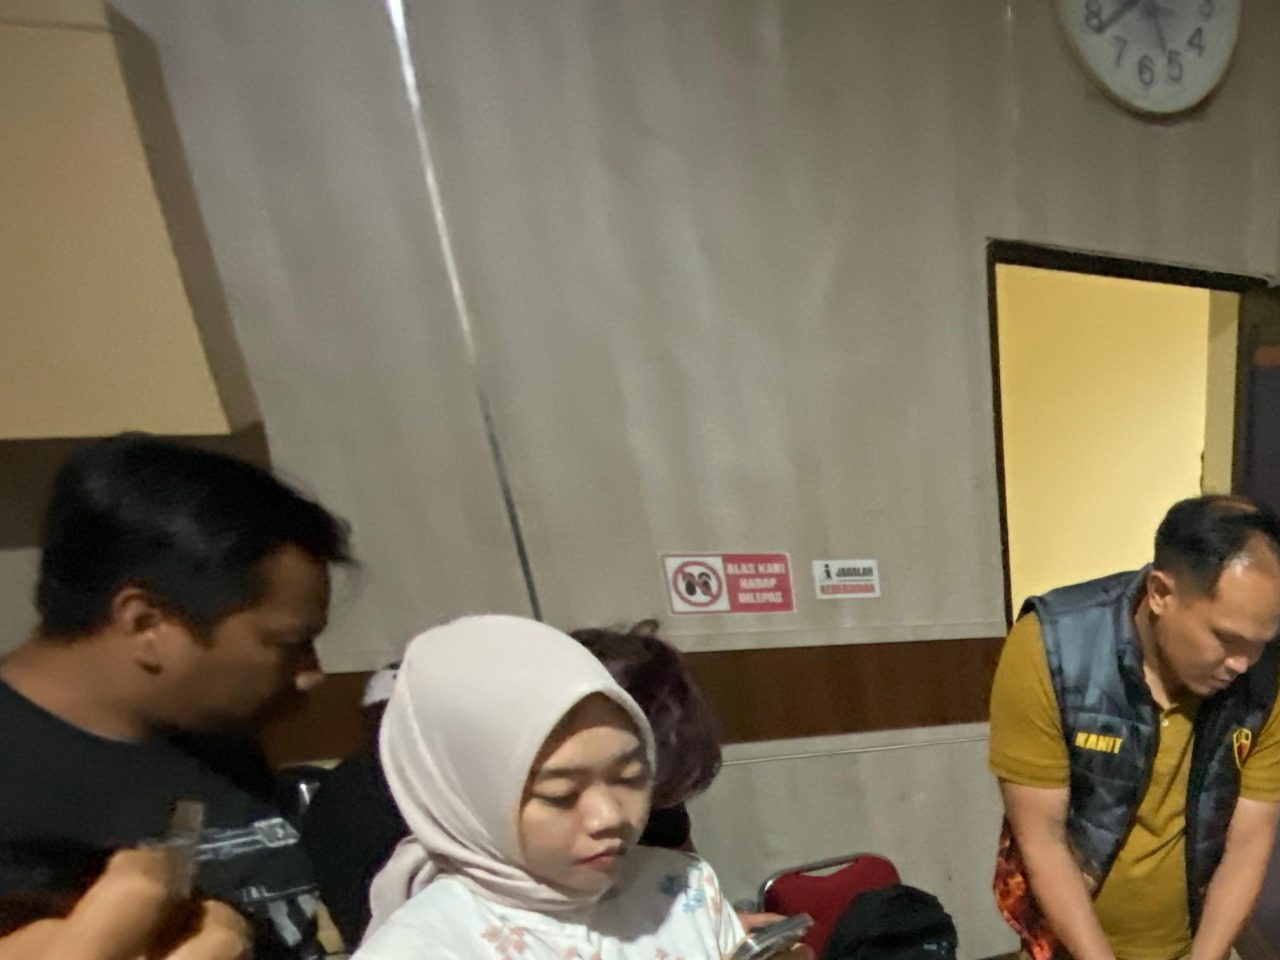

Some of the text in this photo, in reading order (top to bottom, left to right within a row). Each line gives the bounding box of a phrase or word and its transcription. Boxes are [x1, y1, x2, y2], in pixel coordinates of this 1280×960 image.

[1111, 34, 1128, 67] 7
[1187, 26, 1206, 58] 4
[1137, 54, 1154, 86] 6
[1166, 49, 1183, 82] 5
[1074, 731, 1124, 754] KANIT
